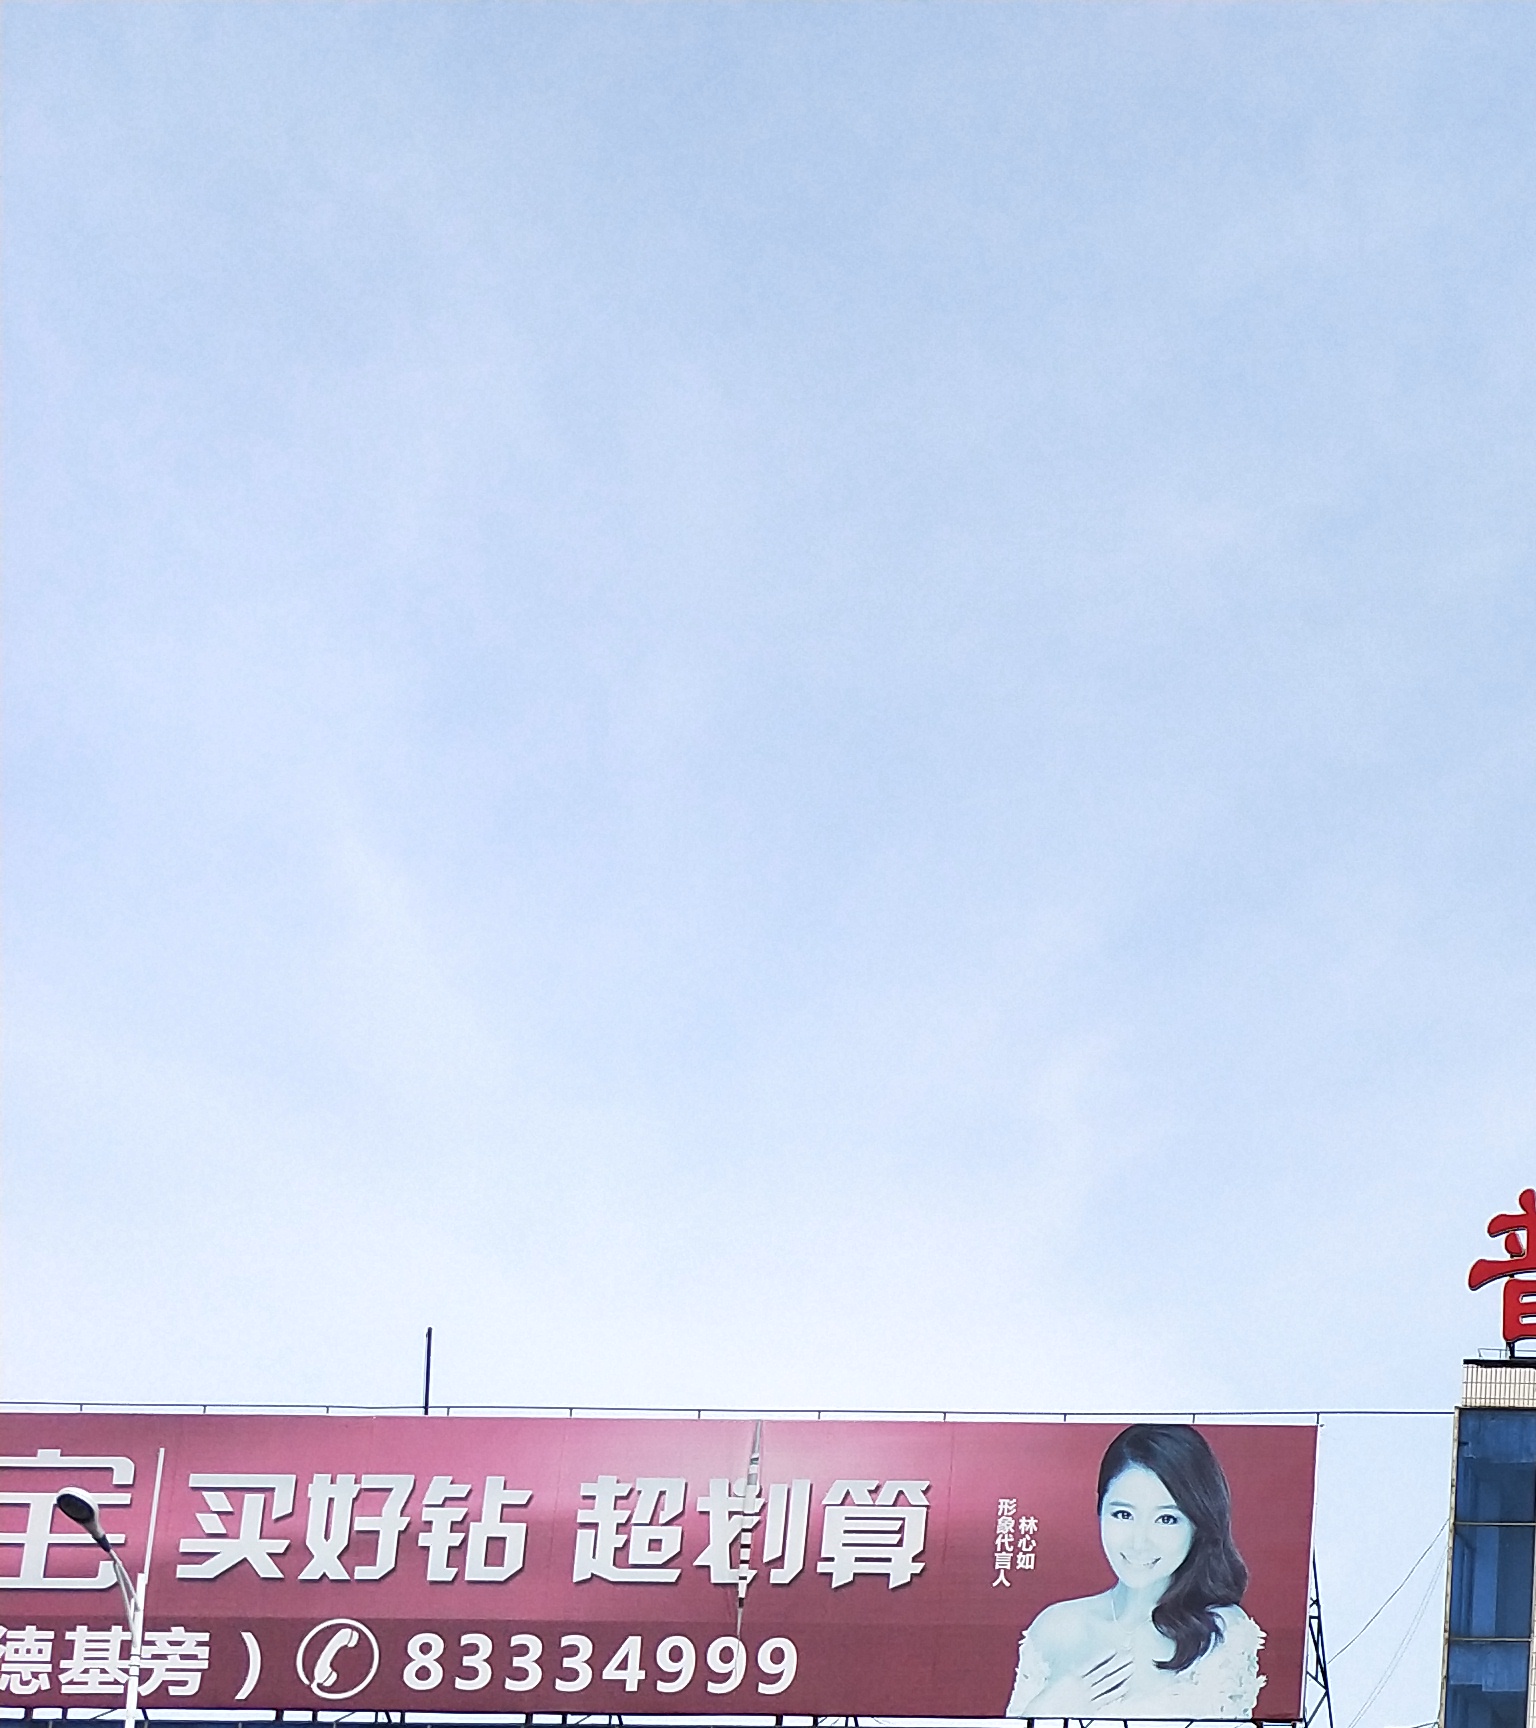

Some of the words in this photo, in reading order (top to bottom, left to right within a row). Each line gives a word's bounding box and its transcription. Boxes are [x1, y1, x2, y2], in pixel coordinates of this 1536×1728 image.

[176, 1472, 534, 1584] 买好钻
[572, 1475, 931, 1590] 超划算
[991, 1498, 1017, 1588] 形象代言人
[1015, 1515, 1039, 1571] 林心如
[402, 1632, 799, 1695] 83334999
